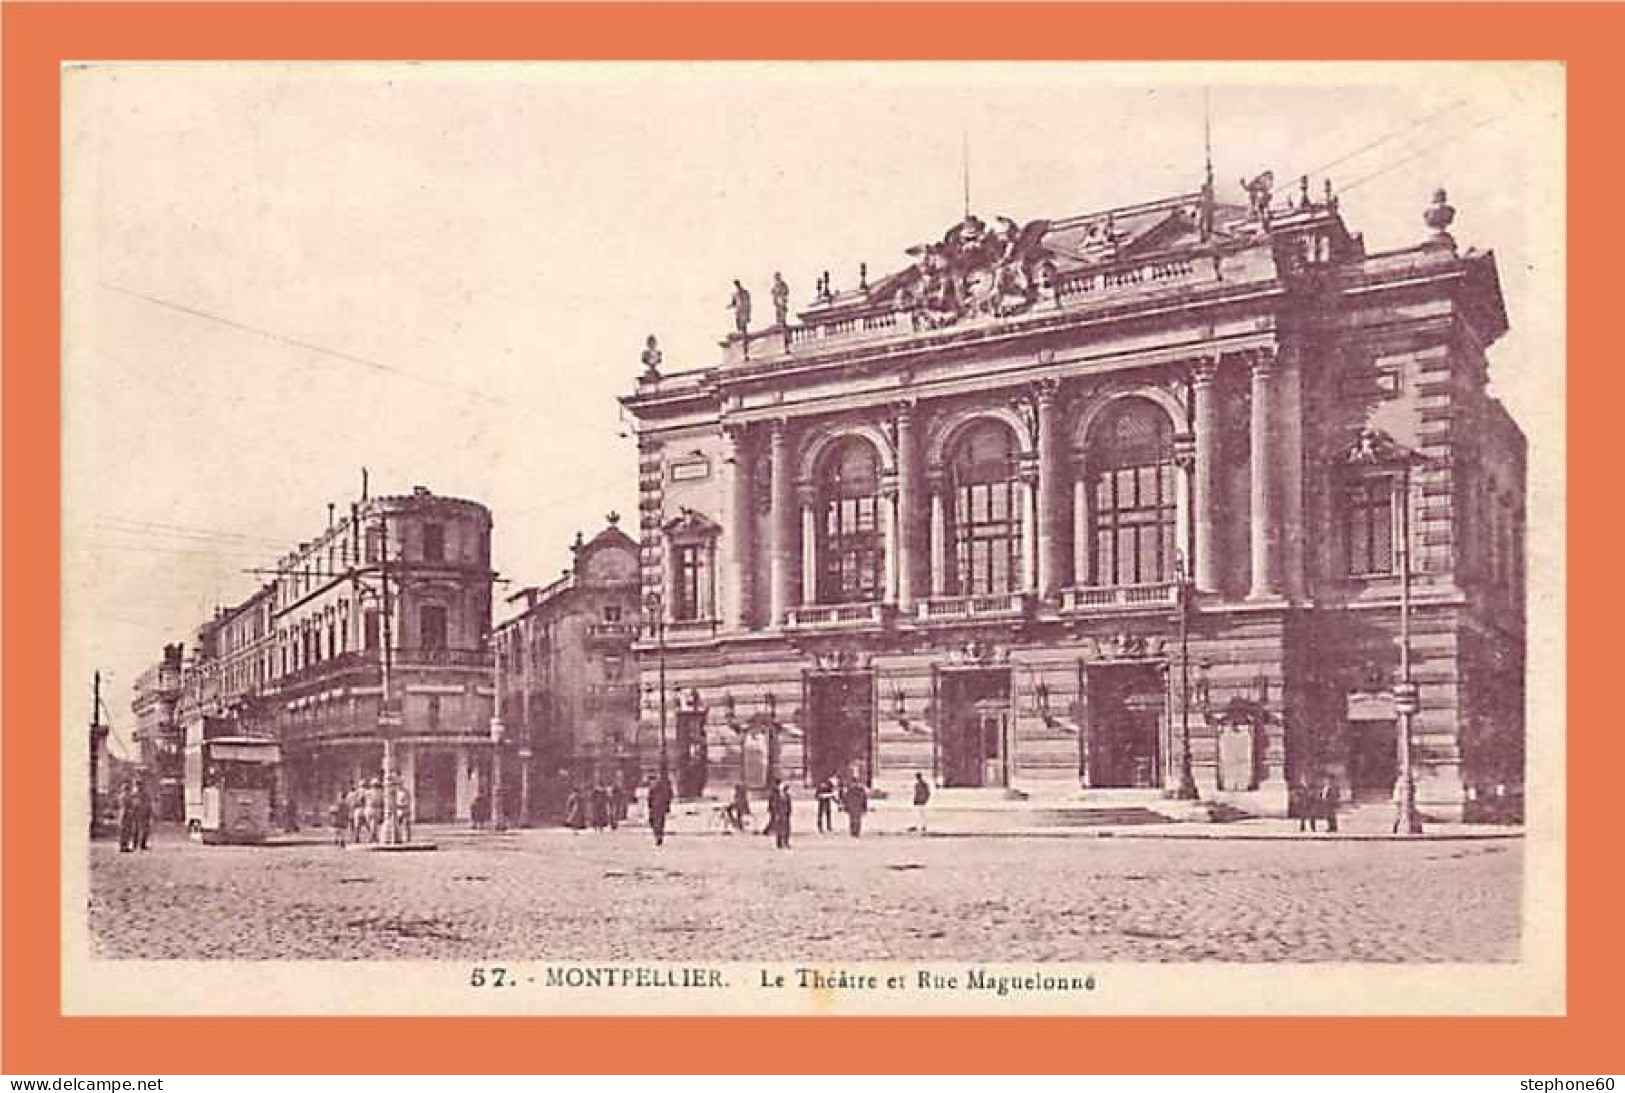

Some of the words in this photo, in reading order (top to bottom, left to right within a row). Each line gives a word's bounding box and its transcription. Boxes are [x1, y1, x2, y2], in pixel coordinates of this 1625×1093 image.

[470, 967, 516, 987] 57.
[545, 967, 731, 987] MONTPELLIER.
[760, 969, 785, 988] Le
[886, 974, 905, 989] et
[917, 969, 958, 989] Rue
